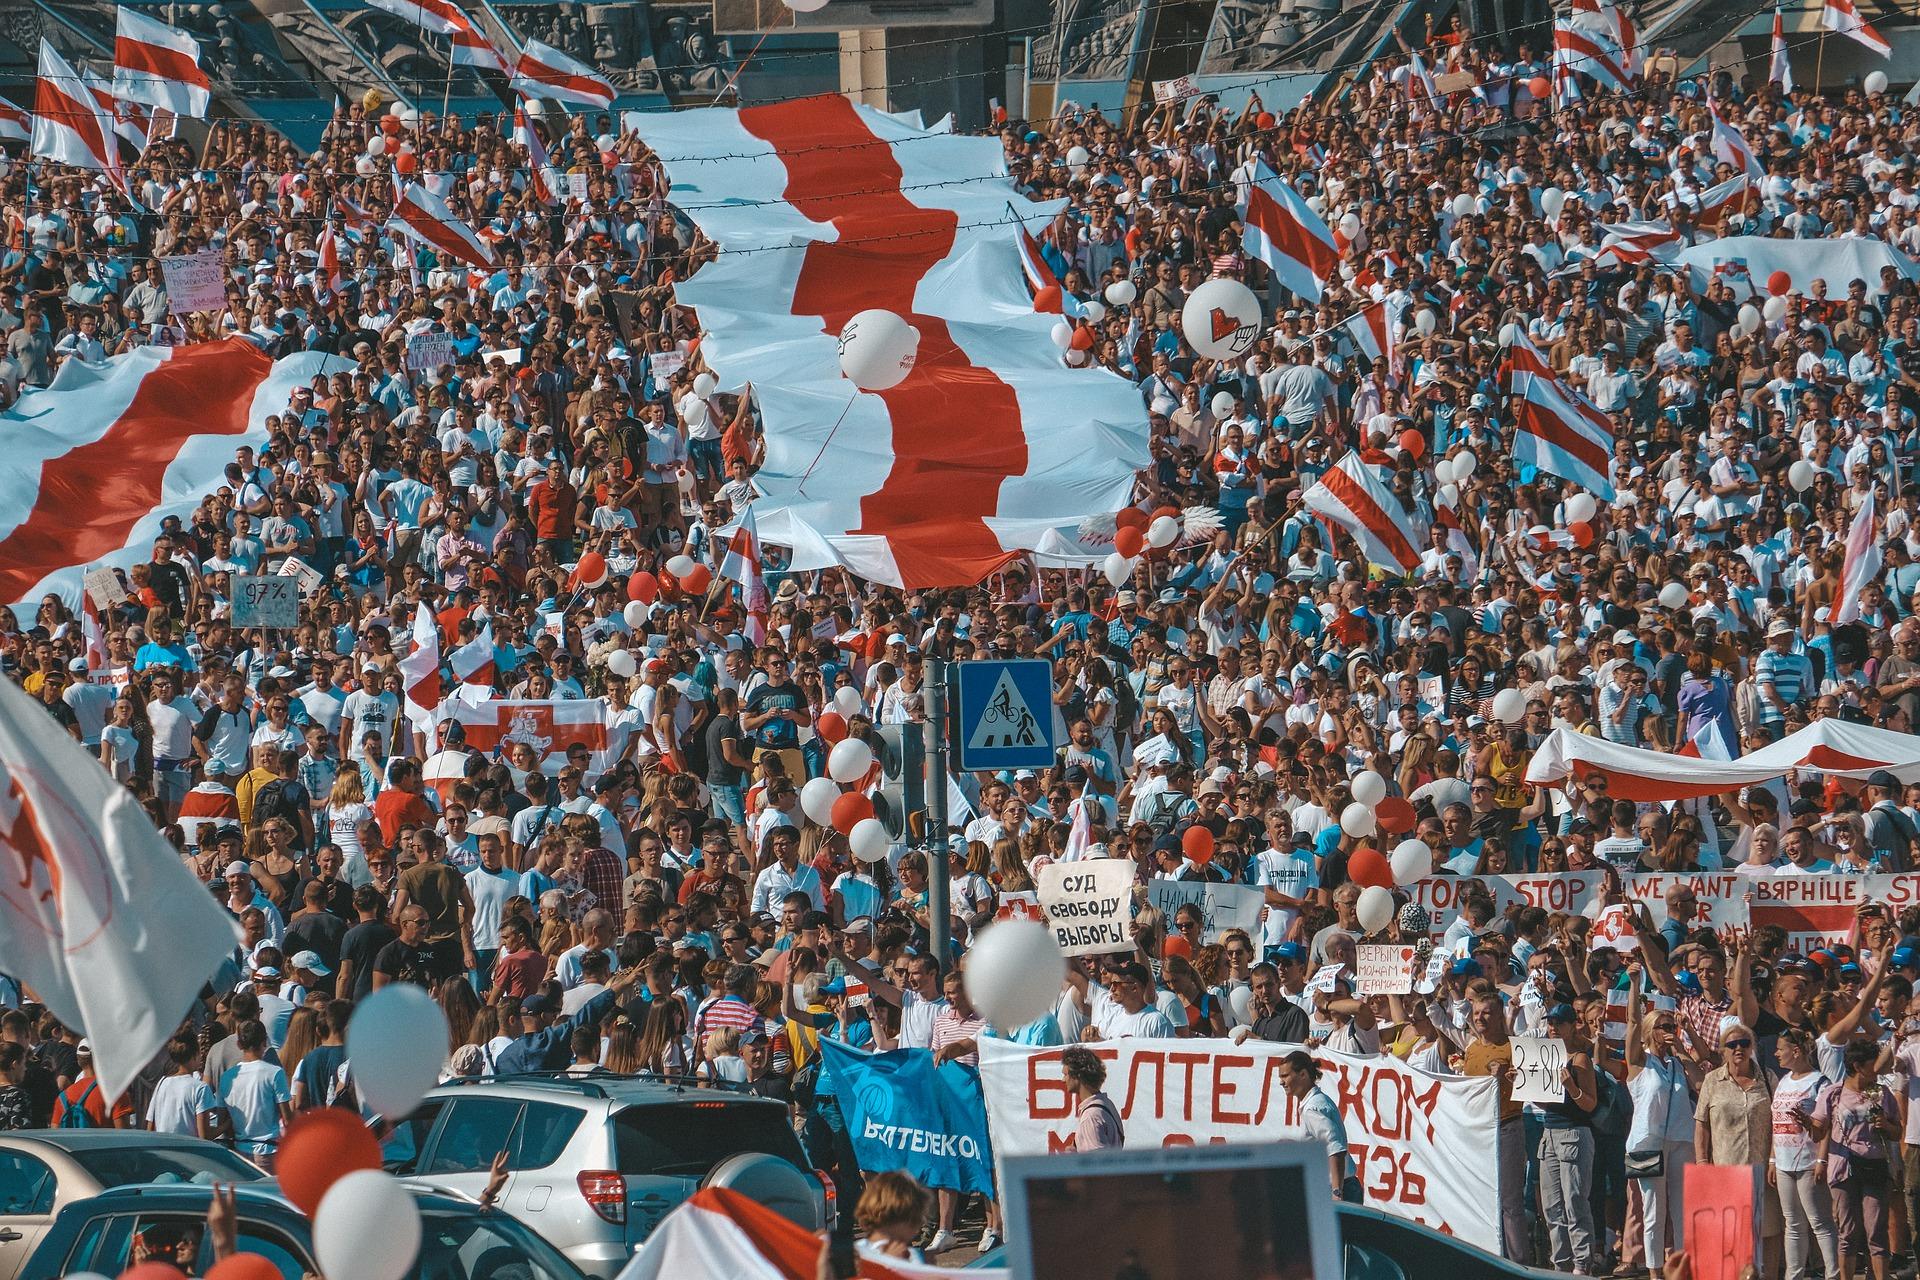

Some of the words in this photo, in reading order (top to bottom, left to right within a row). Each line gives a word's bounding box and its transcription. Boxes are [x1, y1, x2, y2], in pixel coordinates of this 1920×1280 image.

[1173, 77, 1189, 88] FOR
[246, 583, 287, 605] 97%
[1062, 874, 1097, 893] СУД
[1515, 878, 1586, 910] STOP
[1632, 877, 1664, 899] WE
[1050, 897, 1120, 918] СВОБОДУ
[1056, 922, 1125, 948] ВЫБОРЫ
[1358, 945, 1399, 962] ВЕРЫМ
[1321, 971, 1334, 981] НЕ
[1359, 965, 1398, 977] МОЖАМ
[863, 1116, 983, 1165] БЛТЕЛЕКО
